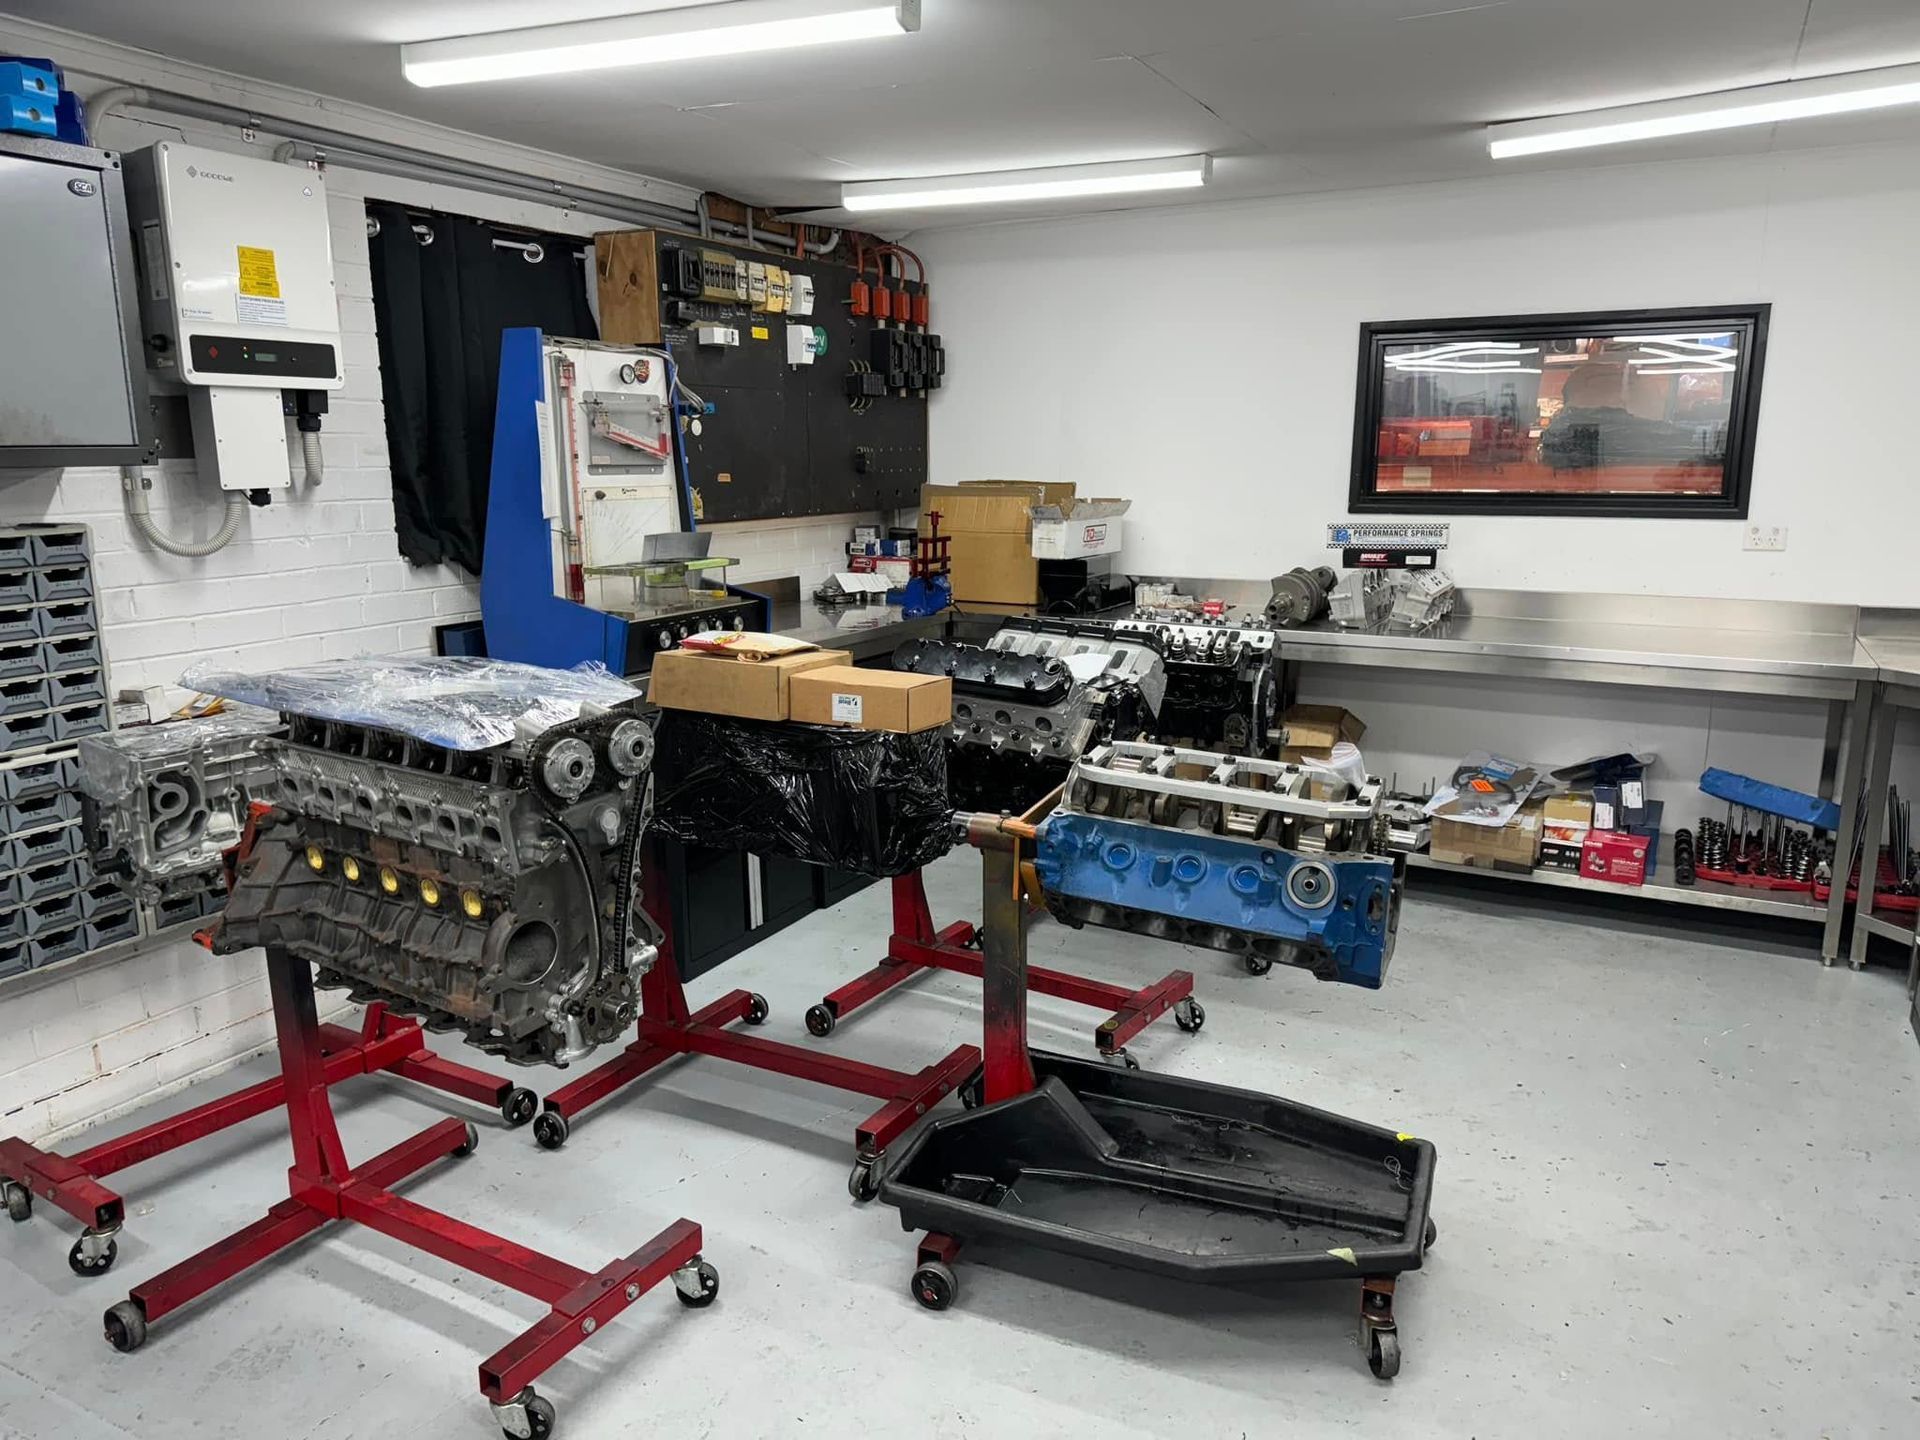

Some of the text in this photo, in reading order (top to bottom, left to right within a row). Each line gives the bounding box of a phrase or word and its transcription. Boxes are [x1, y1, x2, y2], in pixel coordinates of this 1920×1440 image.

[75, 180, 92, 192] SCA
[1353, 529, 1444, 537] PERFORMANCE SPRINGS
